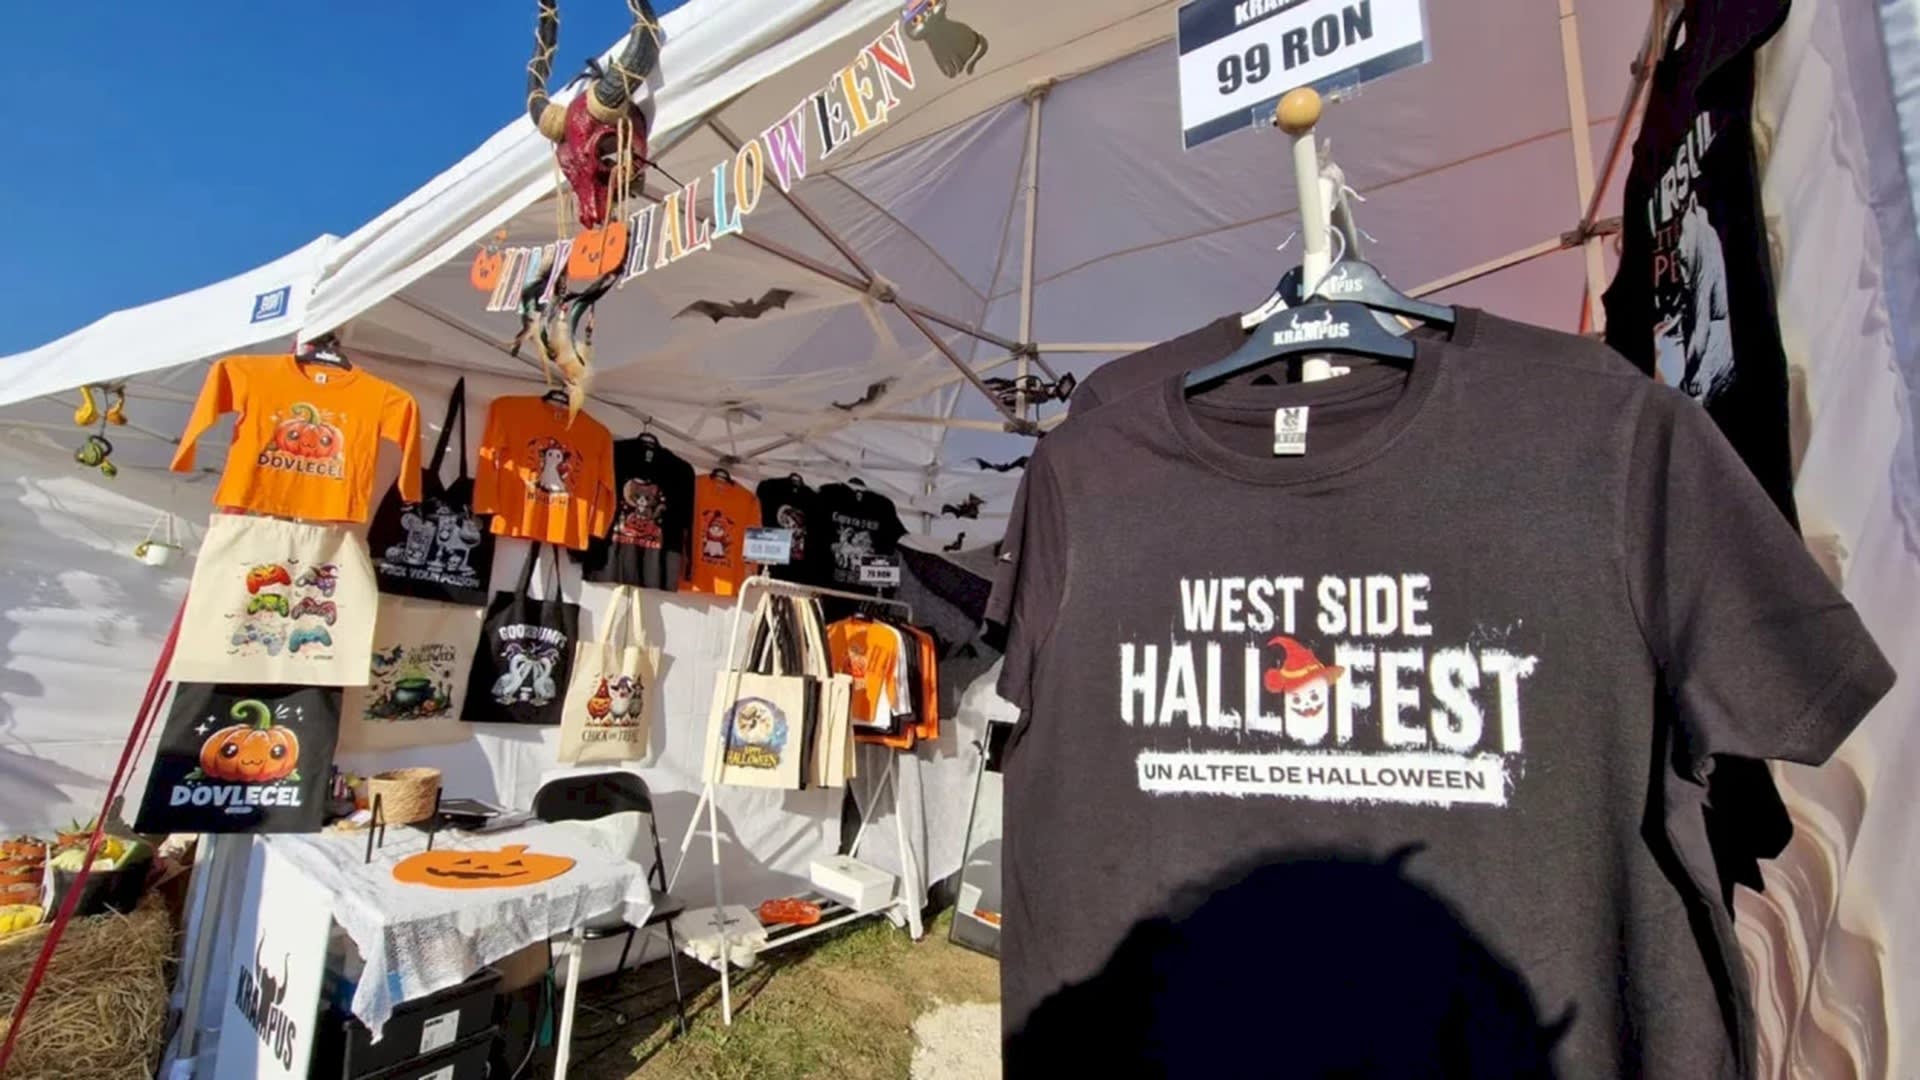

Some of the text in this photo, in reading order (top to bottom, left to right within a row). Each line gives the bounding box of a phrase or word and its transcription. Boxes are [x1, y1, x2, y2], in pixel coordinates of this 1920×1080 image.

[1235, 0, 1297, 26] KRA
[1216, 2, 1374, 95] 99 RON
[617, 20, 916, 289] HALLOWEEN
[1272, 320, 1350, 346] KRAMPUS
[257, 452, 345, 478] DOVLECEL
[1180, 573, 1433, 637] WEST SIDE
[1144, 763, 1487, 791] UN ALTFEL DE HALLOWEEN
[169, 784, 303, 808] DOVLECEL
